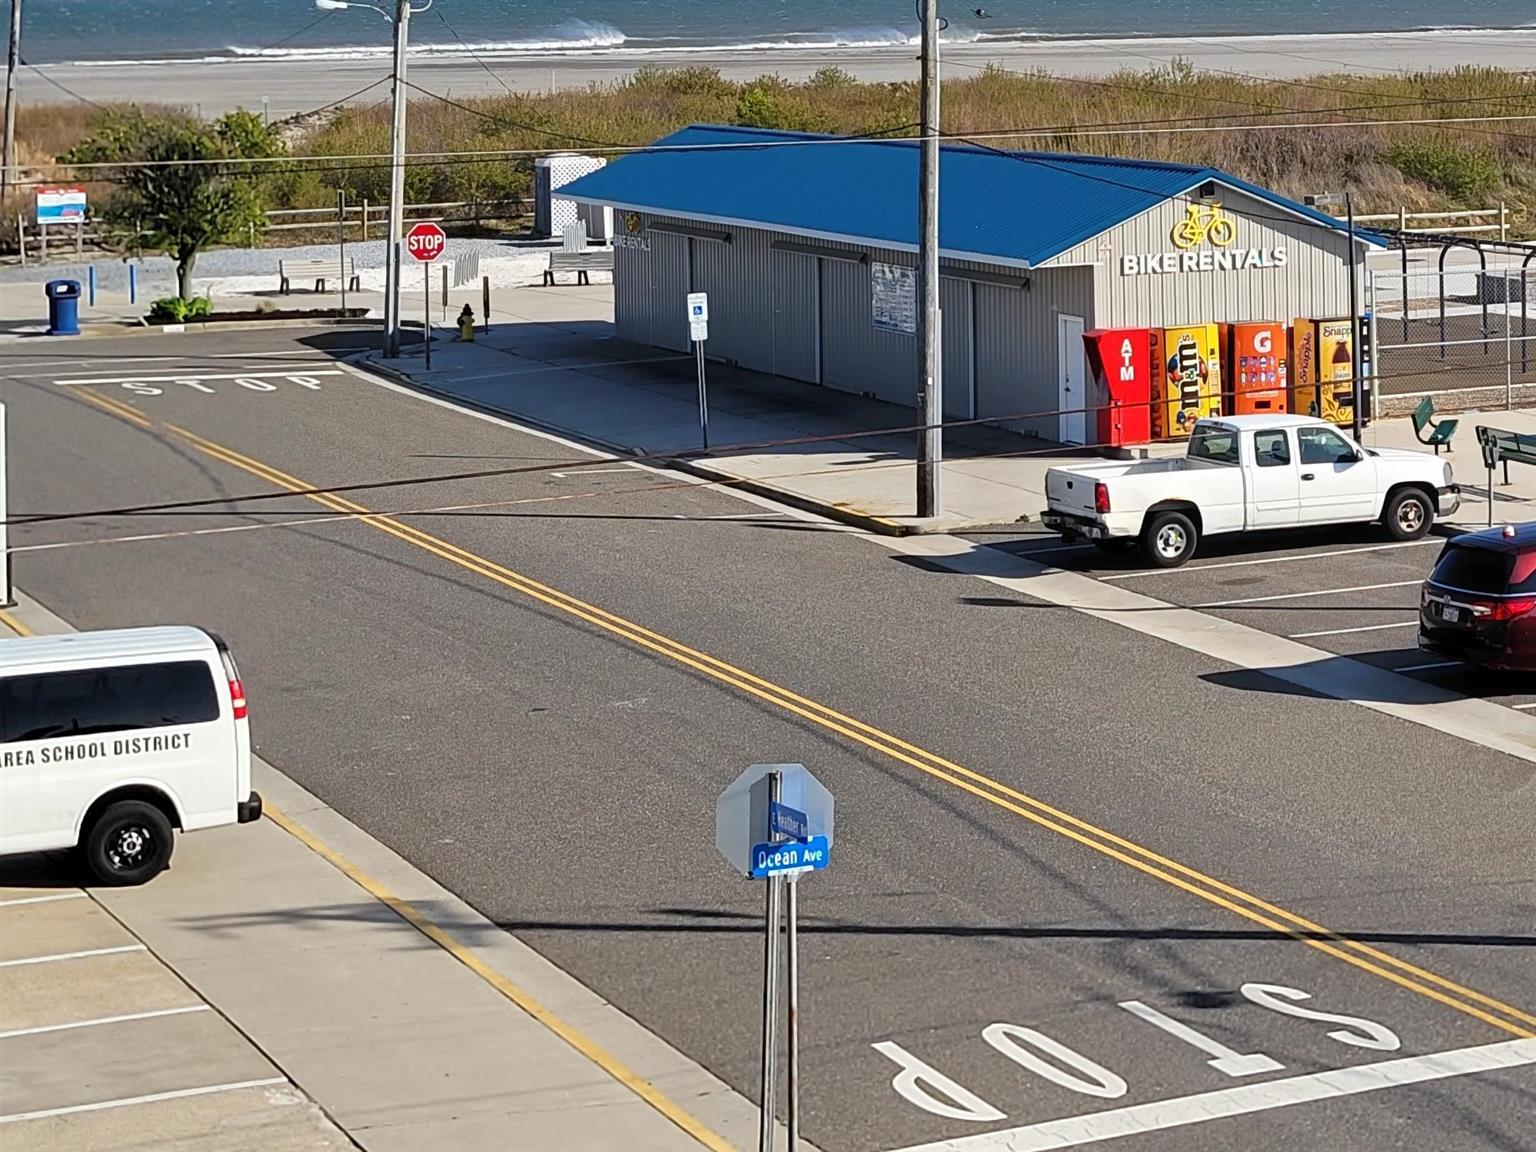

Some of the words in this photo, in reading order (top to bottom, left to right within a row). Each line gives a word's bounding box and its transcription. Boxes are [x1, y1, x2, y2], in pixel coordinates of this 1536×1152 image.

[410, 234, 443, 250] STOP
[1122, 252, 1177, 276] BIKE
[1181, 247, 1288, 273] RENTALS
[1253, 331, 1272, 353] G
[1323, 326, 1353, 337] Snapp
[1120, 338, 1135, 381] ATM
[1299, 331, 1312, 384] Snapple
[121, 375, 322, 395] STOP
[40, 741, 108, 764] SCHOOL
[113, 733, 191, 756] DISTRICT
[758, 850, 798, 869] Ocean
[802, 849, 823, 863] Ave
[871, 982, 1402, 1121] STOP
